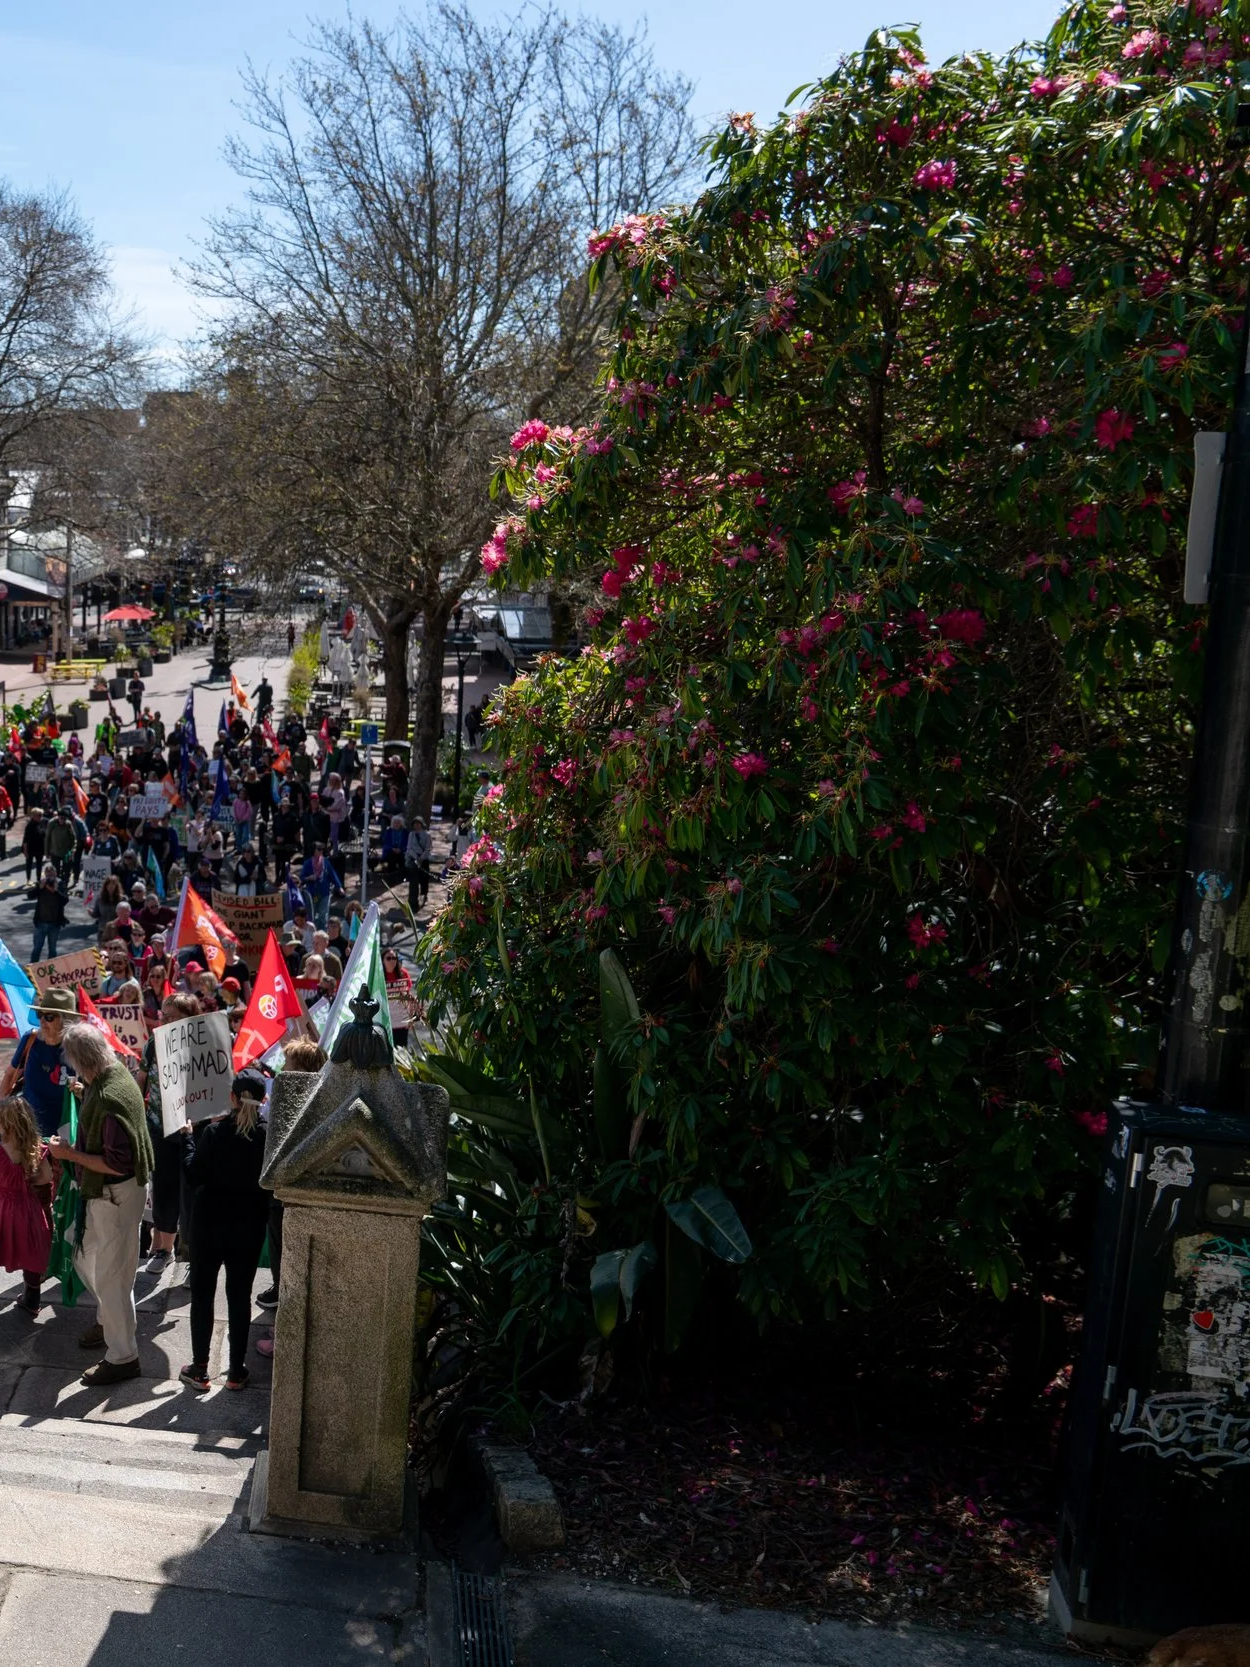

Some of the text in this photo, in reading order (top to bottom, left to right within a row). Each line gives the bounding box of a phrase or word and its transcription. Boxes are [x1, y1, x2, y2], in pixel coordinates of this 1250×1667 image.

[233, 909, 266, 919] GIANT
[37, 964, 56, 977] OUR
[50, 966, 97, 985] DEMOCRACY
[100, 1005, 140, 1021] TRUST
[164, 1020, 207, 1057] WE ARE
[162, 1061, 179, 1090] SAD
[191, 1049, 229, 1080] MAD
